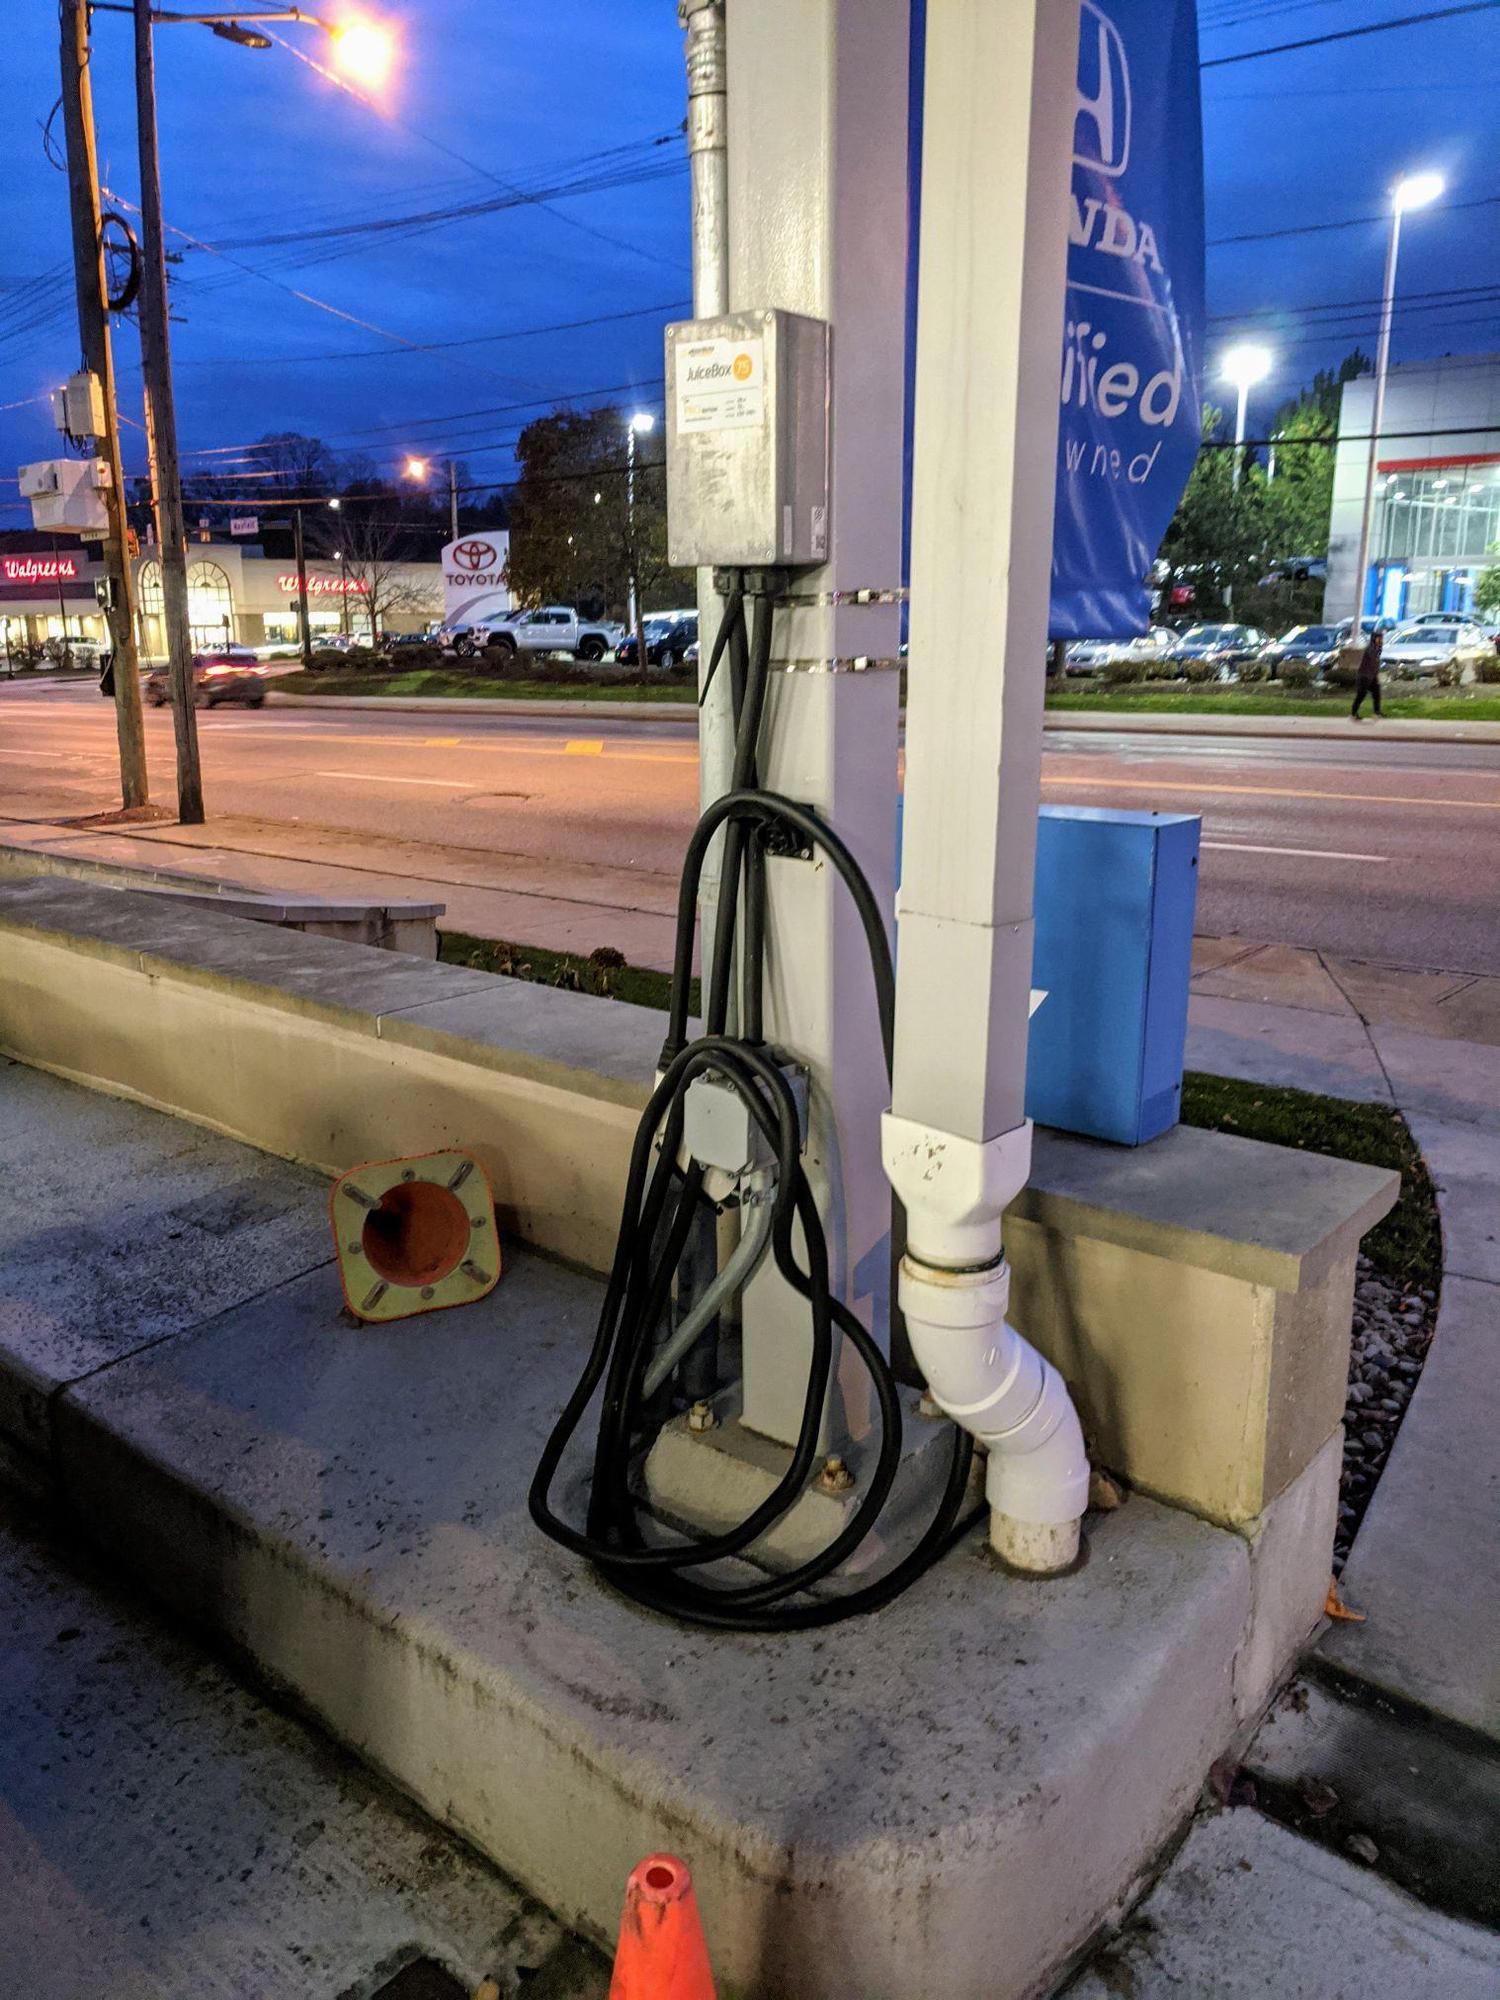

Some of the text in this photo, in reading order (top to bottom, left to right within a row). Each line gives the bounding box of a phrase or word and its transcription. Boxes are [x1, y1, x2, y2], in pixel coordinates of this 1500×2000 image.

[1069, 194, 1164, 276] NDA
[687, 363, 732, 382] JuiceBox
[1066, 440, 1162, 484] wned
[5, 559, 75, 583] Walgreens
[446, 573, 506, 586] TOYOTA
[279, 576, 369, 596] Wlgreens
